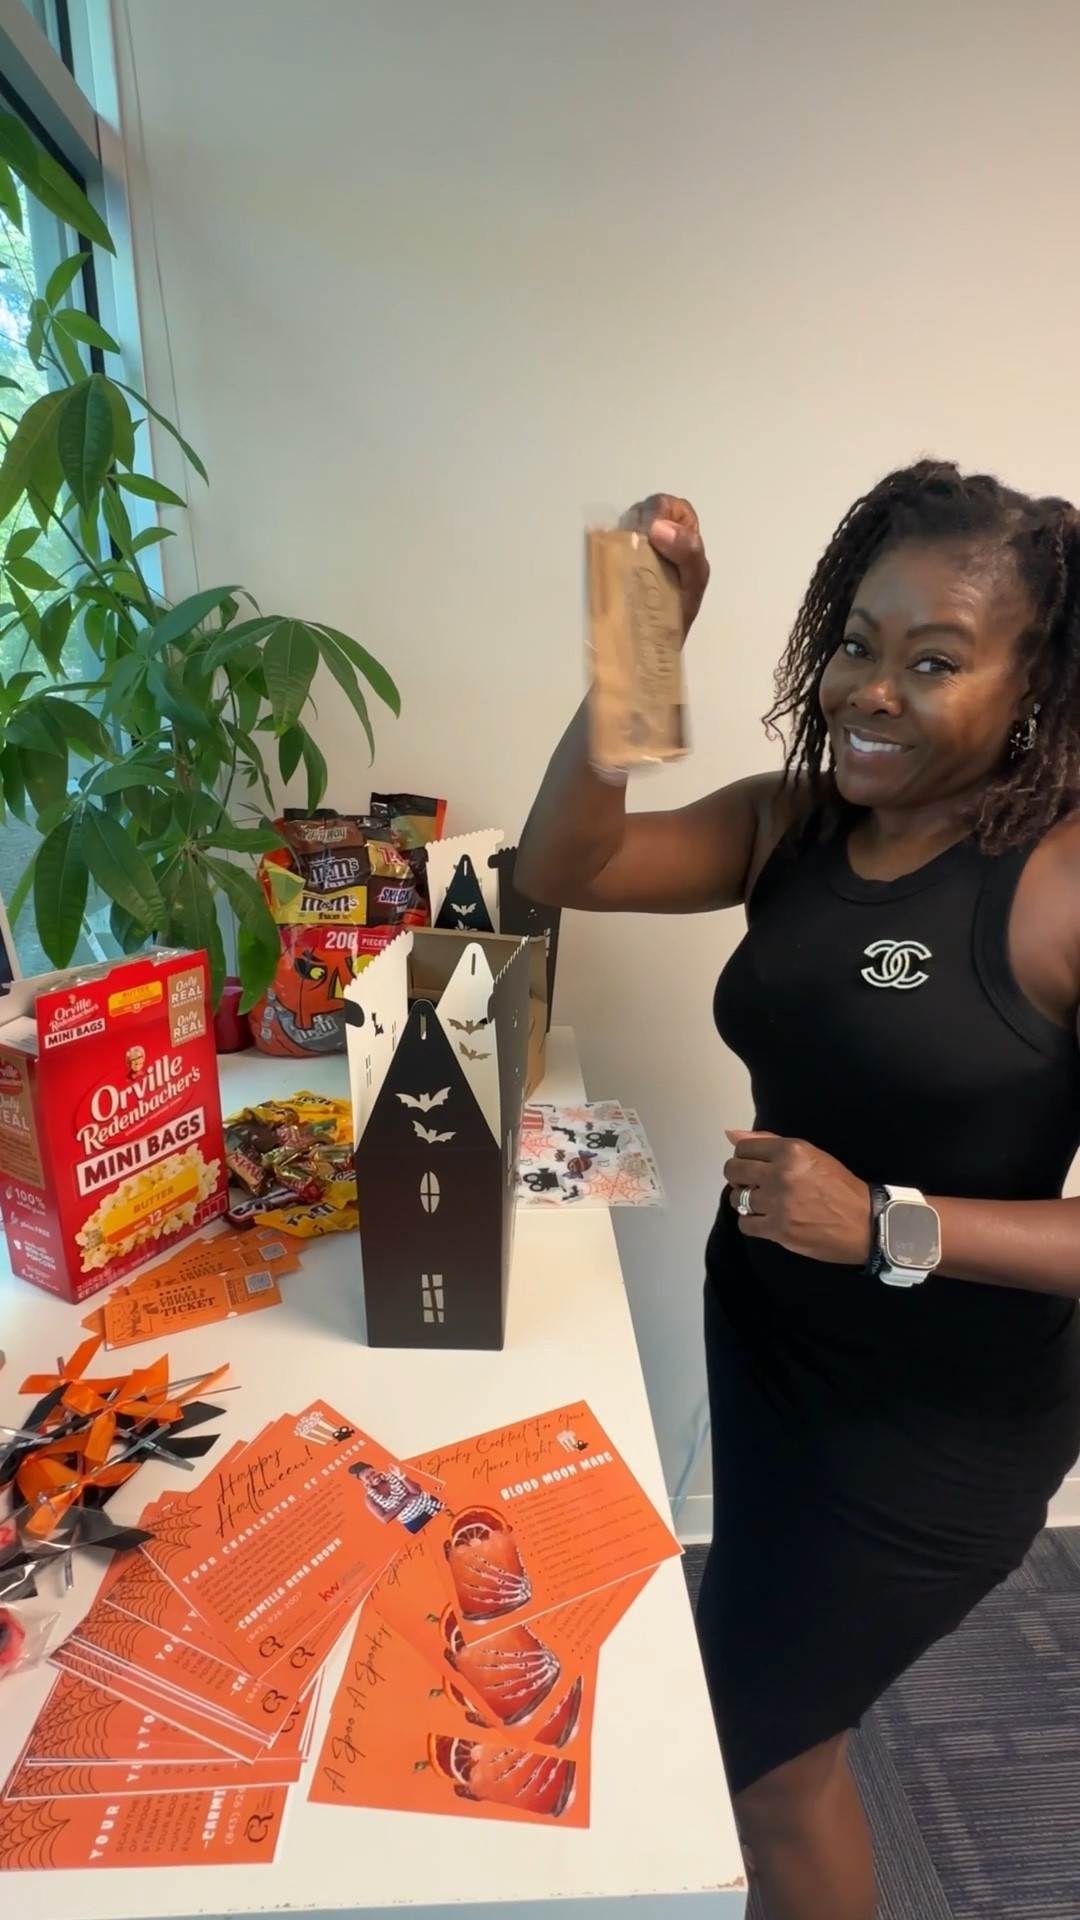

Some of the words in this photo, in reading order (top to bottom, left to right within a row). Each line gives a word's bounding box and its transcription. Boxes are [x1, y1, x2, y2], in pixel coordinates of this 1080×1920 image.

[380, 887, 412, 905] SNICK
[325, 930, 357, 950] 200
[361, 937, 388, 947] PIECES
[171, 988, 203, 1004] REAL
[176, 976, 197, 992] Only
[54, 998, 92, 1021] Orville
[177, 1010, 198, 1027] Only
[48, 1030, 74, 1046] MINI
[77, 1020, 103, 1037] BAGS
[173, 1021, 204, 1038] REAL
[91, 1055, 183, 1122] Orville
[2, 1109, 31, 1132] EAL
[76, 1066, 201, 1156] Redenbacher's
[84, 1142, 142, 1188] MINI
[146, 1114, 201, 1158] BAGS
[15, 1187, 46, 1210] 100%
[133, 1185, 175, 1214] BUTTER
[149, 1209, 163, 1224] 12
[160, 1296, 216, 1318] TICKET
[476, 1424, 526, 1454] Cocktail
[217, 1446, 283, 1505] Happy
[472, 1458, 512, 1484] Movie
[515, 1440, 554, 1472] Night
[500, 1478, 540, 1502] BLOOD
[542, 1463, 578, 1487] MOON
[580, 1451, 614, 1472] MARG
[215, 1444, 315, 1539] Halloween!
[182, 1556, 219, 1585] YOUR
[303, 1473, 320, 1491] SC
[321, 1439, 367, 1479] REALTOR
[312, 1538, 343, 1569] BROWN
[354, 1626, 392, 1687] Spooky
[346, 1686, 367, 1711] A
[332, 1717, 366, 1764] Spoo
[323, 1766, 346, 1793] A
[89, 1804, 121, 1860] YOUR
[199, 1787, 227, 1849] -CARMI
[222, 1810, 241, 1846] (843)
